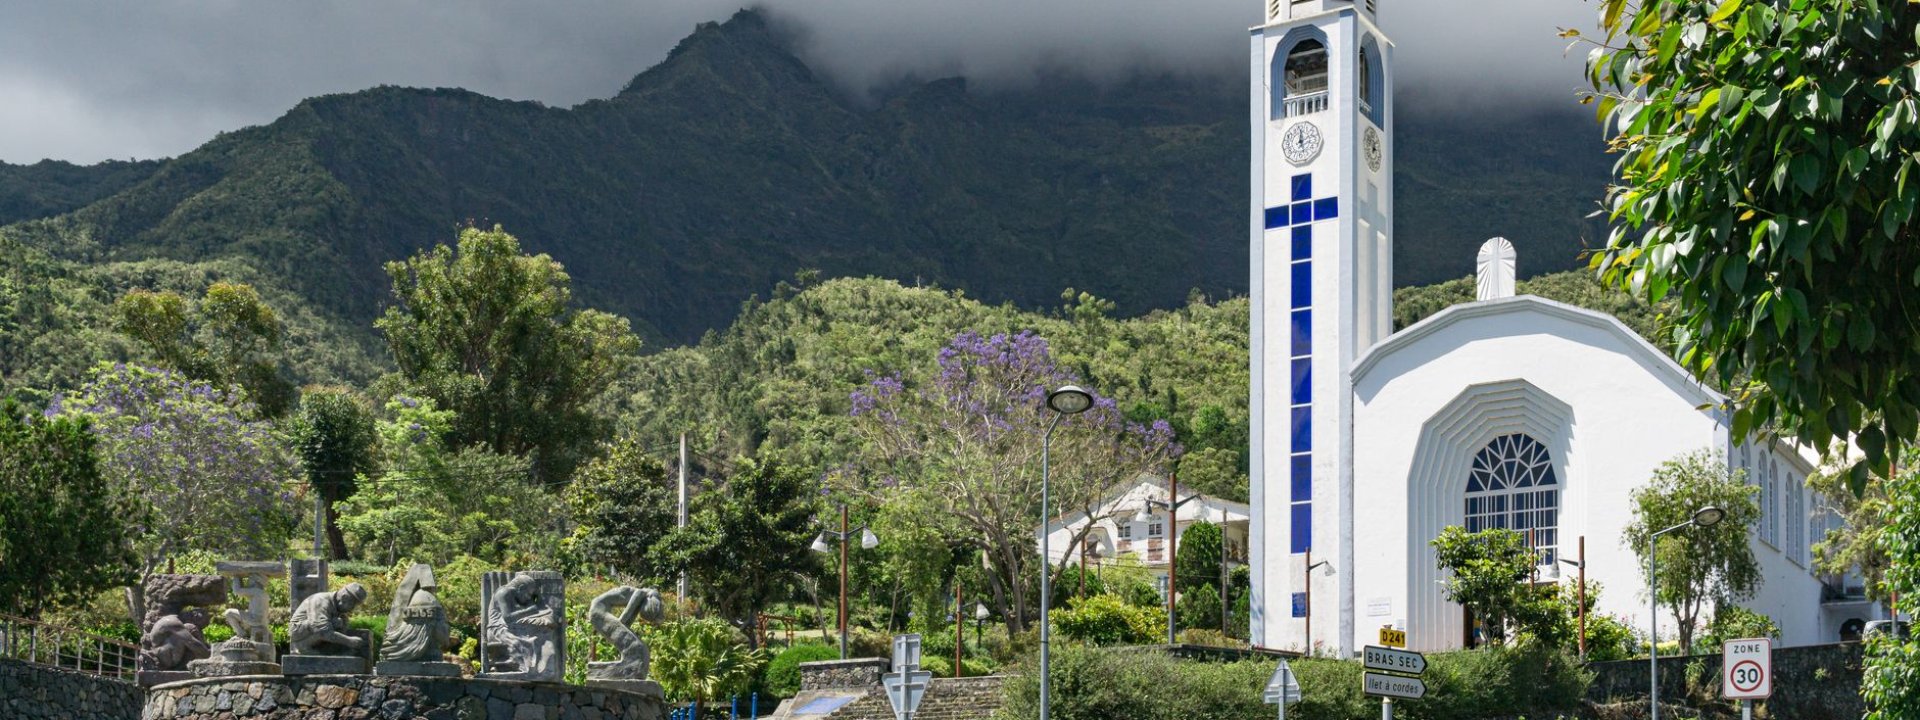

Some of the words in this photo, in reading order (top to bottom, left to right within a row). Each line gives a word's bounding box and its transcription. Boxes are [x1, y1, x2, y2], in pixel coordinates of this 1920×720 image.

[1733, 644, 1760, 654] ZONE
[1368, 652, 1394, 665] BRAS
[1398, 656, 1418, 668] SEC
[1736, 668, 1759, 684] 30
[1392, 682, 1419, 693] cordes
